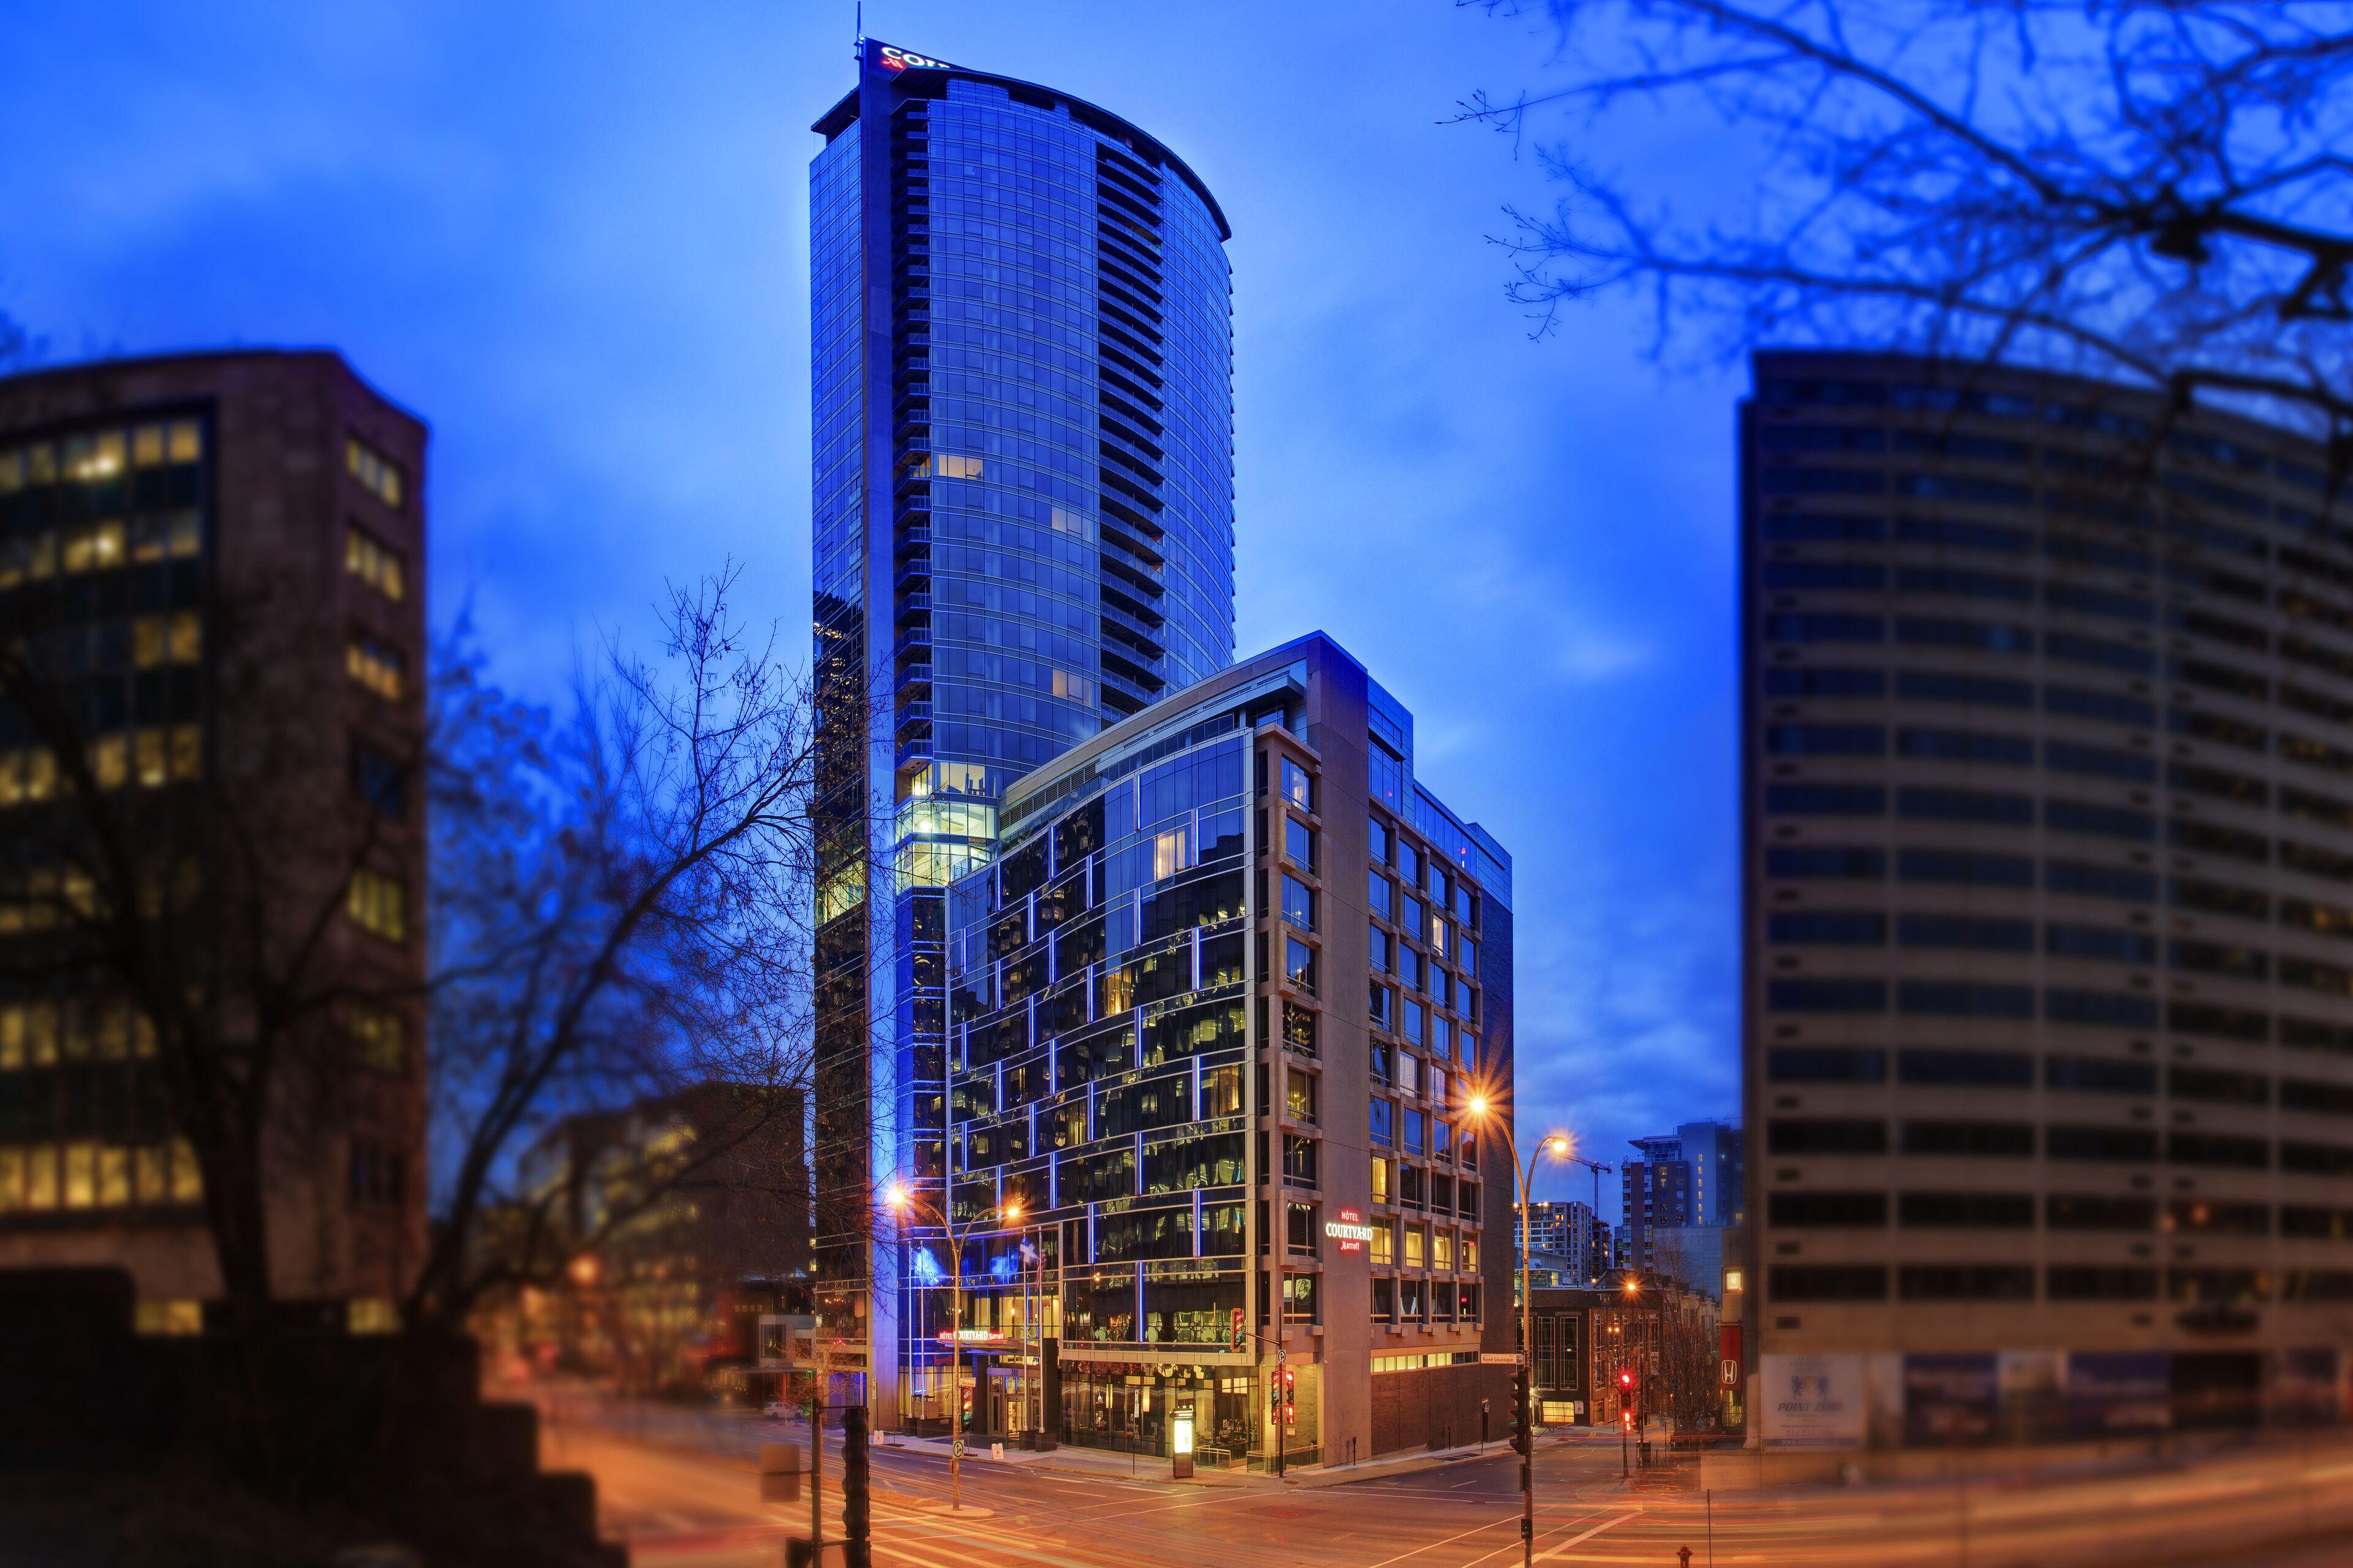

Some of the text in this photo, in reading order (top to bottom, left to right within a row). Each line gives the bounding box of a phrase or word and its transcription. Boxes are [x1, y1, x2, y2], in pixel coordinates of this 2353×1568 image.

[1341, 1210, 1358, 1221] HÔTEL
[1325, 1222, 1373, 1241] COURTYARD
[939, 1331, 952, 1340] HÔTEL
[1778, 1402, 1812, 1412] POINT
